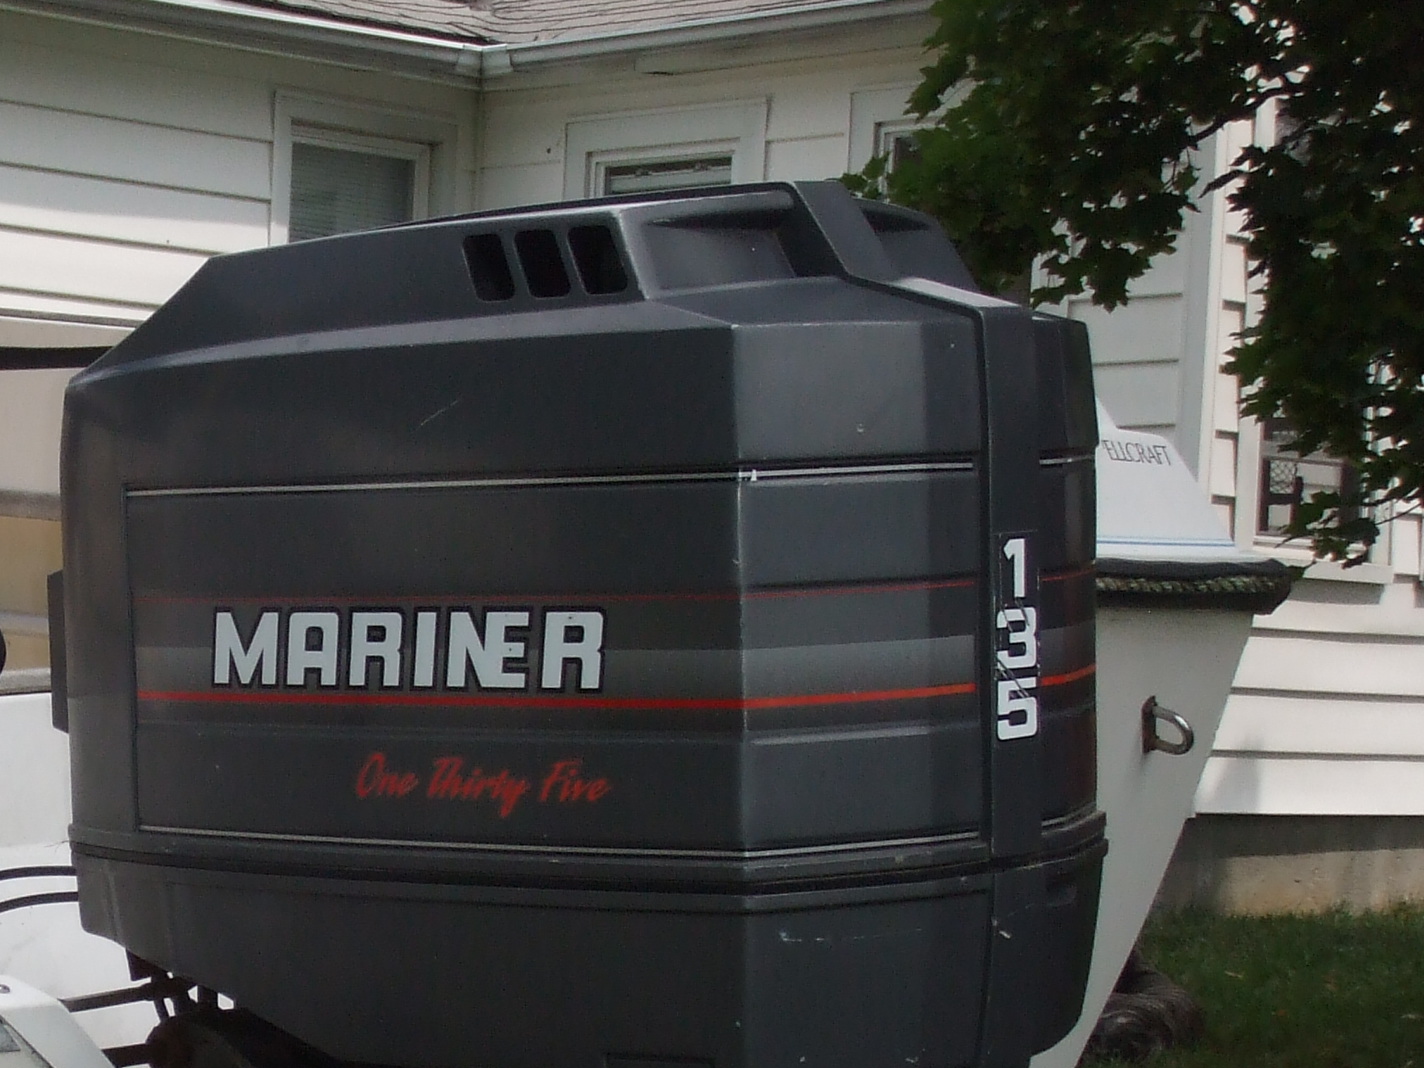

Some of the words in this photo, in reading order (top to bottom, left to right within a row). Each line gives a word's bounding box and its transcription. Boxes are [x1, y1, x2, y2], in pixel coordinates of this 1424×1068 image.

[1101, 439, 1172, 466] ELLCRAFT
[213, 609, 606, 690] MARINER
[996, 537, 1038, 741] 135
[356, 752, 418, 798] One
[428, 757, 530, 818] Thirty
[539, 759, 611, 803] Five
